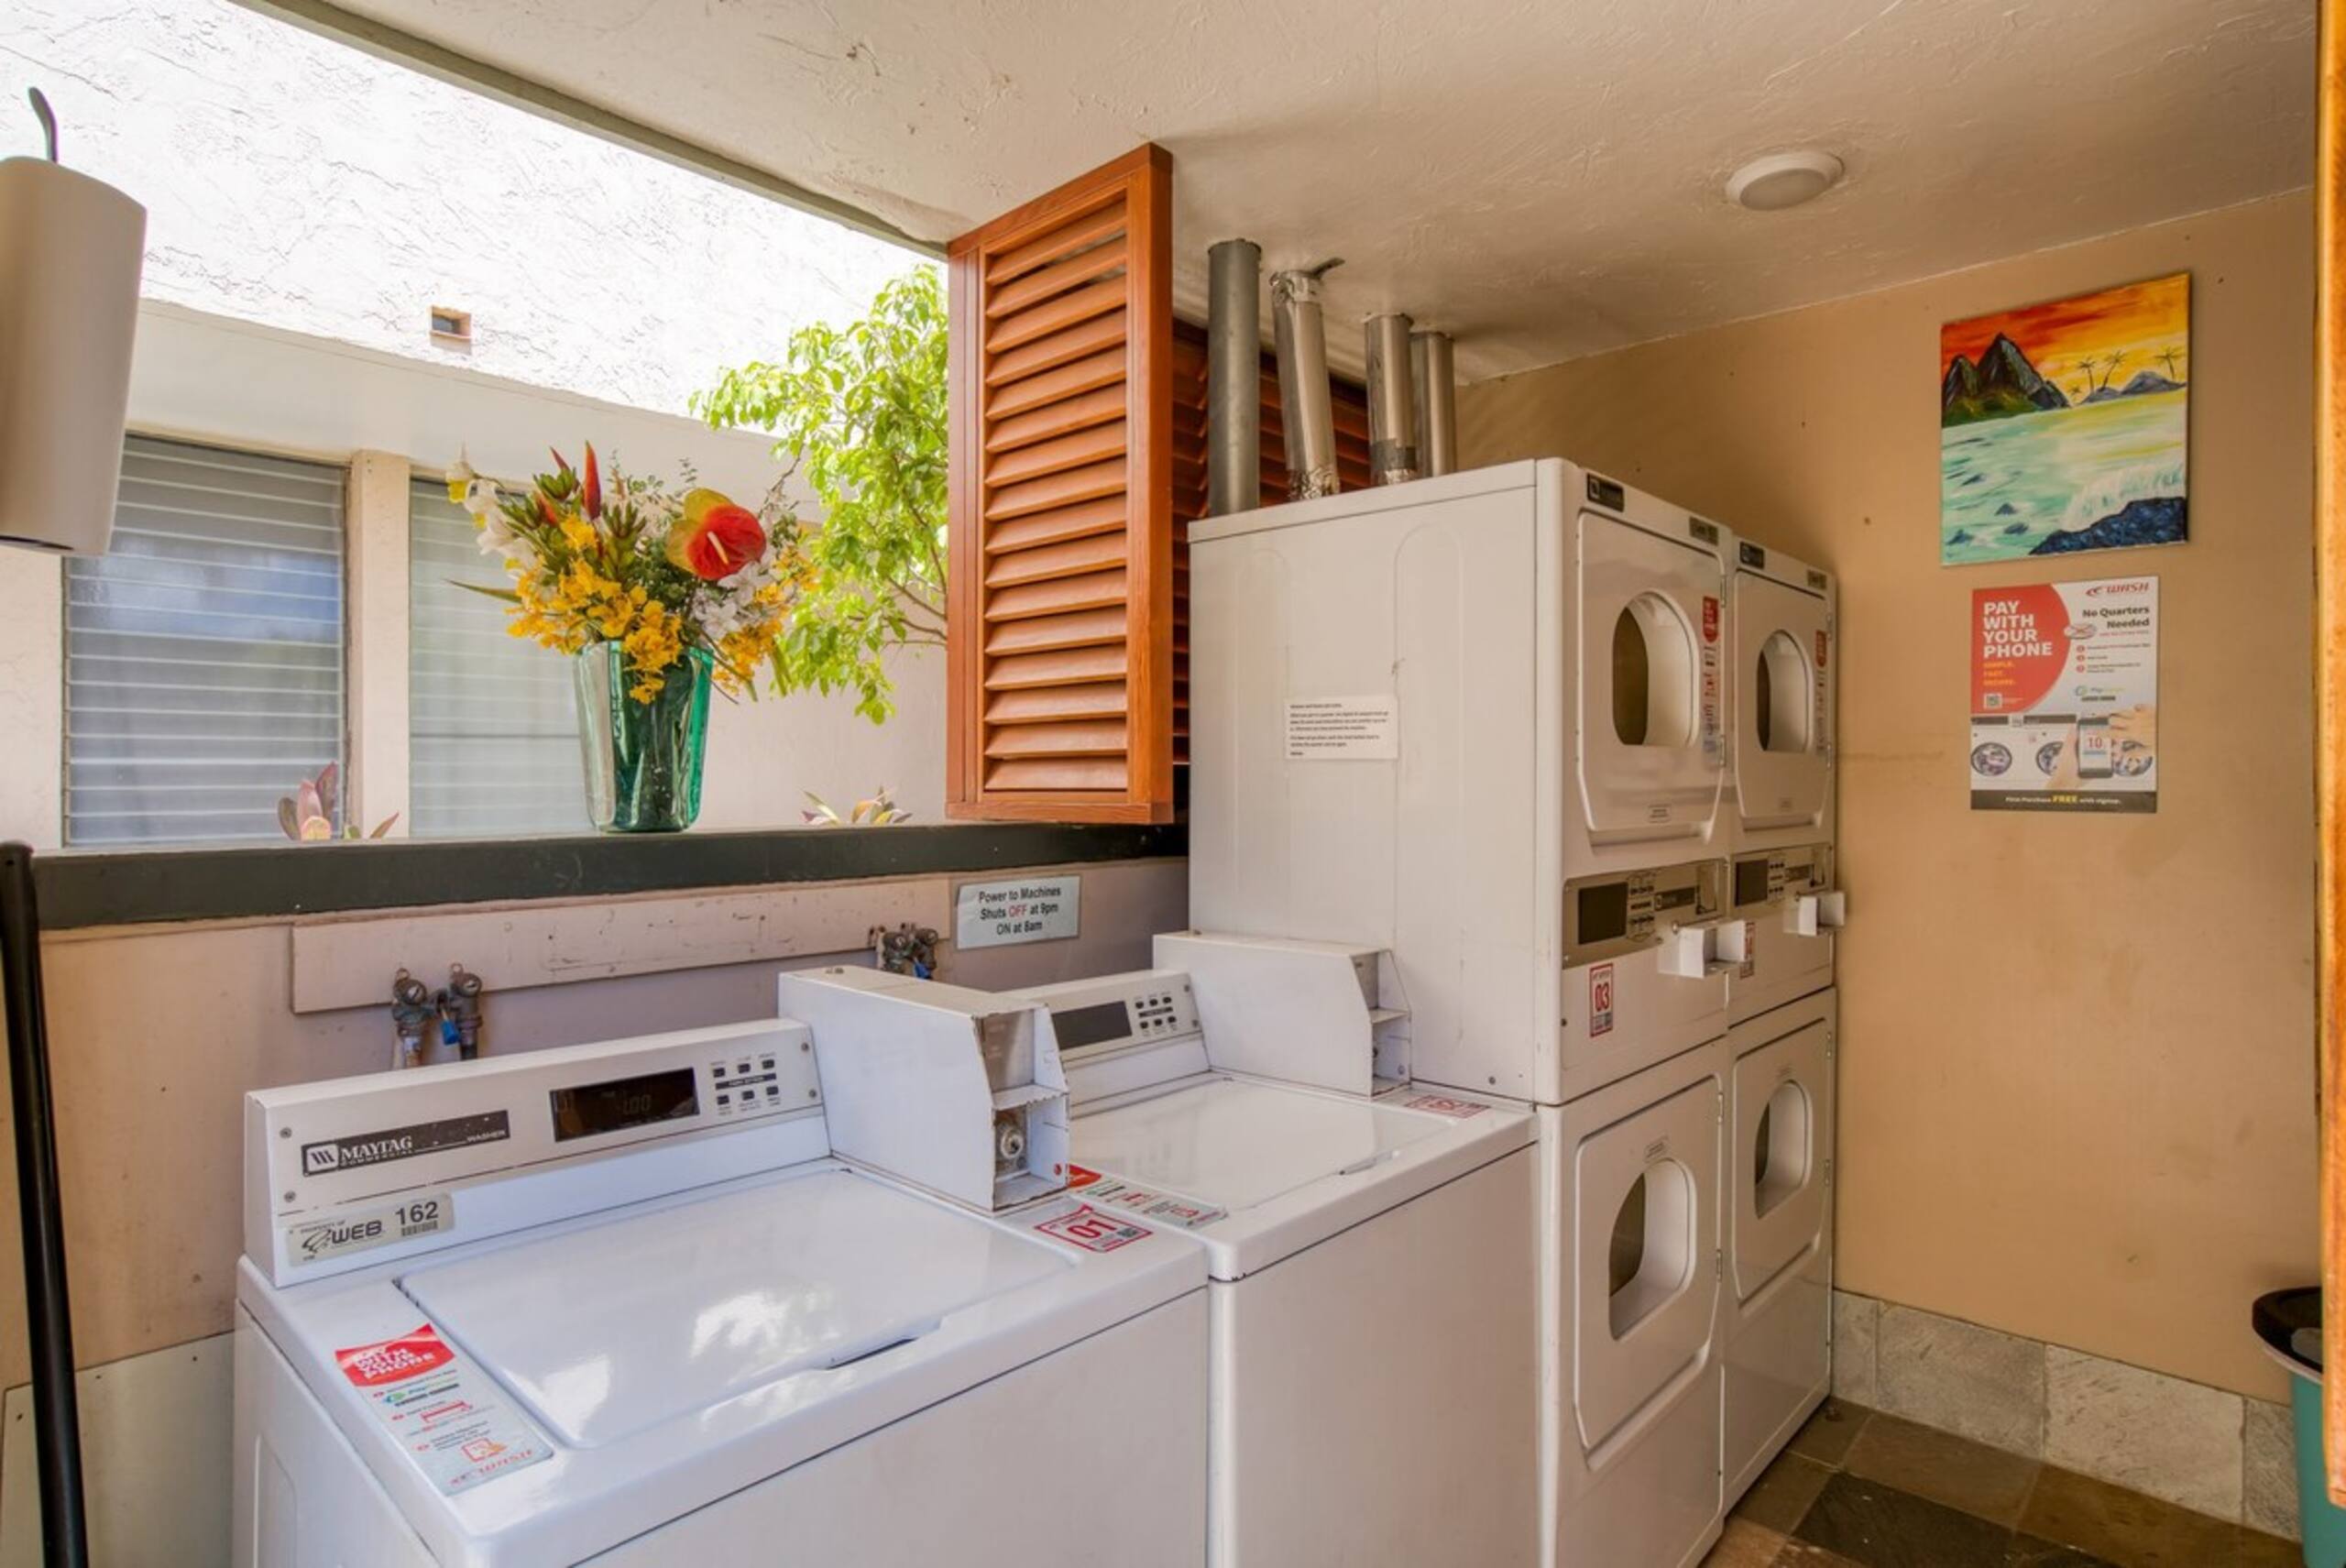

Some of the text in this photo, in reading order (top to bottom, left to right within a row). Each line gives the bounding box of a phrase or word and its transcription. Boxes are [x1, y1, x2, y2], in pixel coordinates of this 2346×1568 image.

[1984, 599, 2021, 615] PAY
[2082, 607, 2150, 619] No Quarters
[1983, 614, 2034, 630] WITH
[2107, 618, 2150, 629] Needed
[1982, 629, 2037, 643] YOUR
[1983, 641, 2054, 659] PHONE
[2053, 795, 2077, 804] FREE
[979, 886, 1061, 903] Power to Machines
[981, 903, 1058, 920] Shuts OFF at 9pm
[997, 923, 1011, 935] ON
[1014, 924, 1022, 934] at
[1595, 982, 1610, 1012] 03
[340, 1135, 412, 1161] MAYTAG
[396, 1201, 439, 1225] 162
[332, 1220, 382, 1245] WEB
[1067, 1219, 1117, 1238] 01
